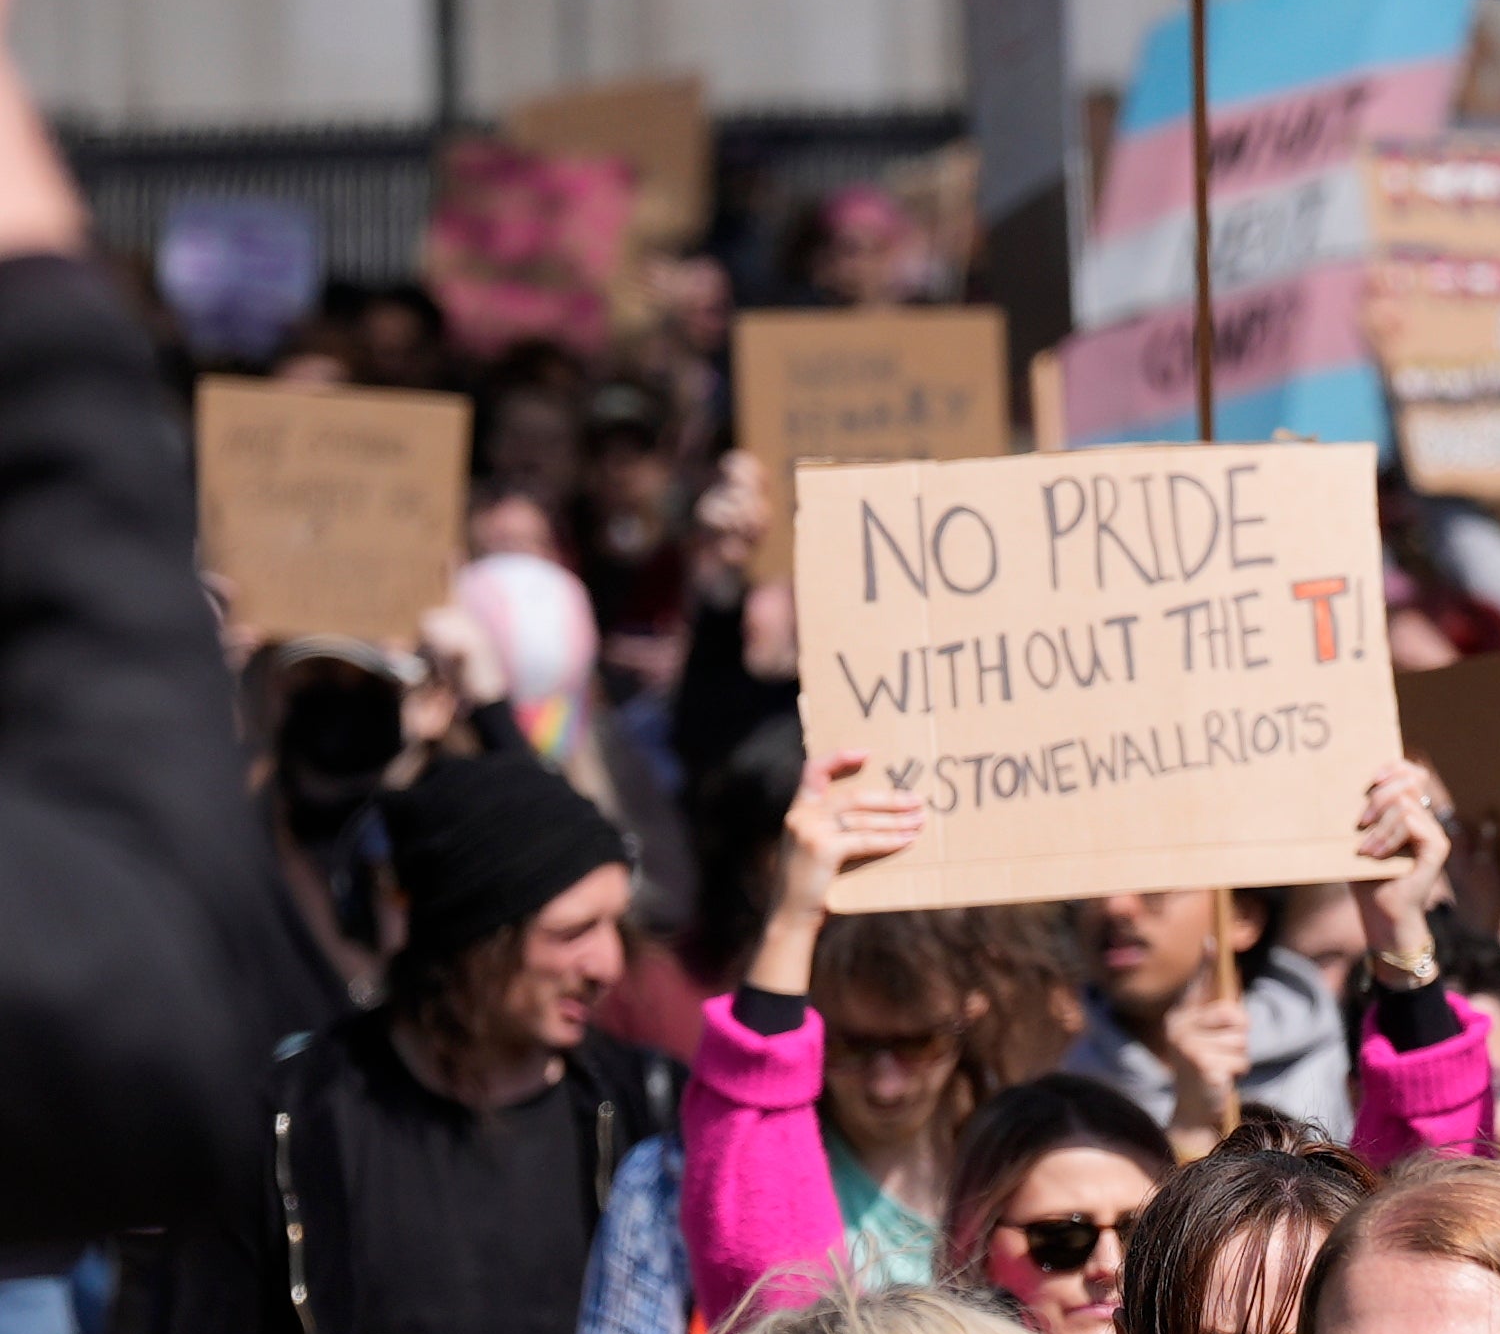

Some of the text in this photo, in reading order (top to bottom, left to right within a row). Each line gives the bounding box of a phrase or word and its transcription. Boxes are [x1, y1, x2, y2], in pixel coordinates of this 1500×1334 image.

[861, 463, 1276, 603] NO PRIDE
[835, 615, 1139, 720] WITHOUT
[1164, 589, 1270, 672] THE
